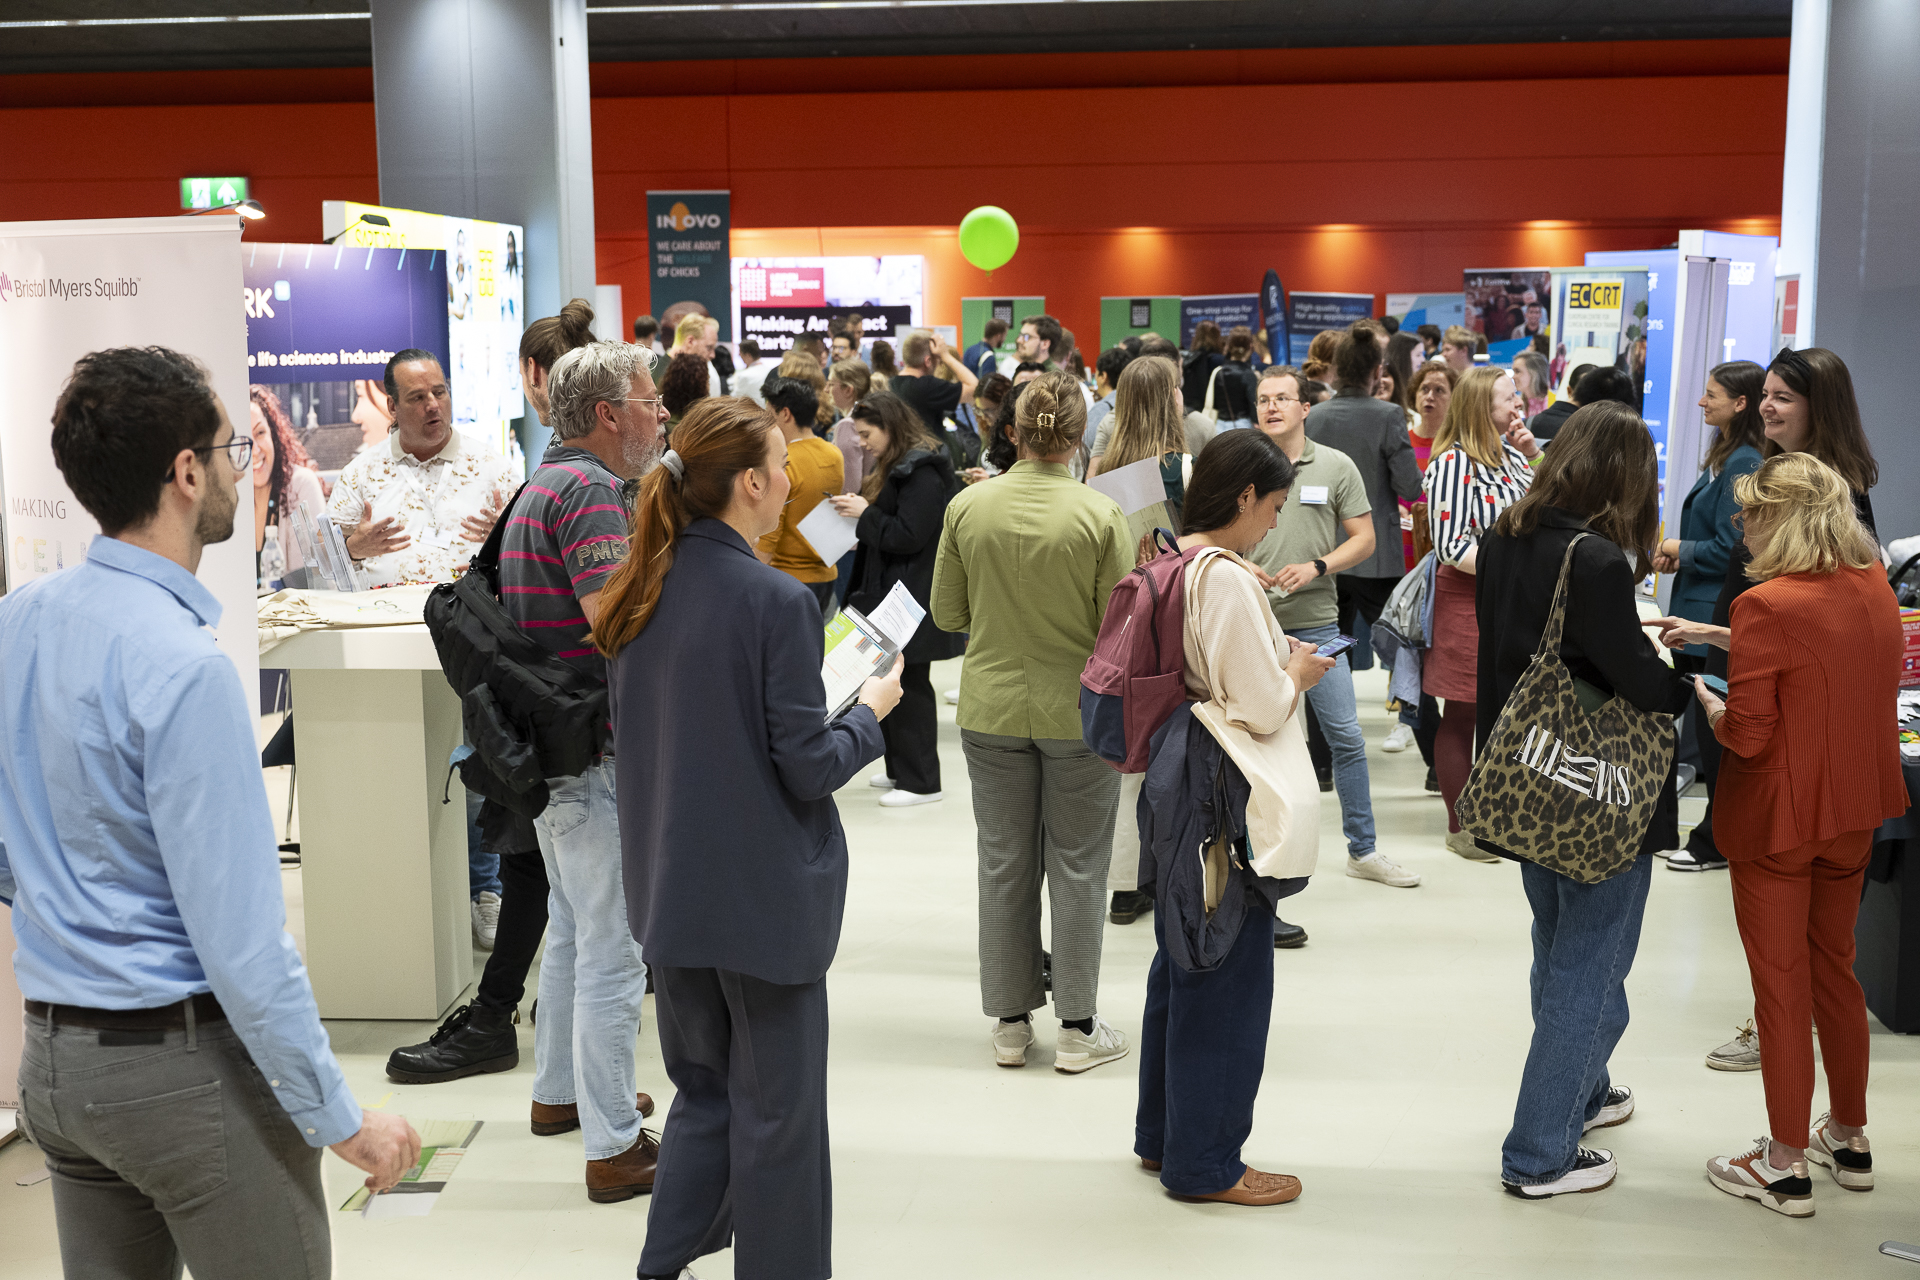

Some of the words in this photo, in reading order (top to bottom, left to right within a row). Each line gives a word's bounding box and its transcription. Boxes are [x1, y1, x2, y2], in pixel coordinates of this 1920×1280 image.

[656, 241, 670, 251] WE
[671, 240, 692, 251] CARE
[693, 240, 721, 251] ABOUT
[658, 253, 674, 265] THE
[657, 266, 668, 278] OF
[669, 266, 700, 278] CHICKS
[14, 279, 46, 298] Bristol
[49, 278, 92, 301] Myers
[745, 315, 804, 334] Making
[806, 315, 829, 331] An
[257, 351, 277, 367] life
[279, 350, 338, 366] sciences
[12, 497, 66, 519] MAKING
